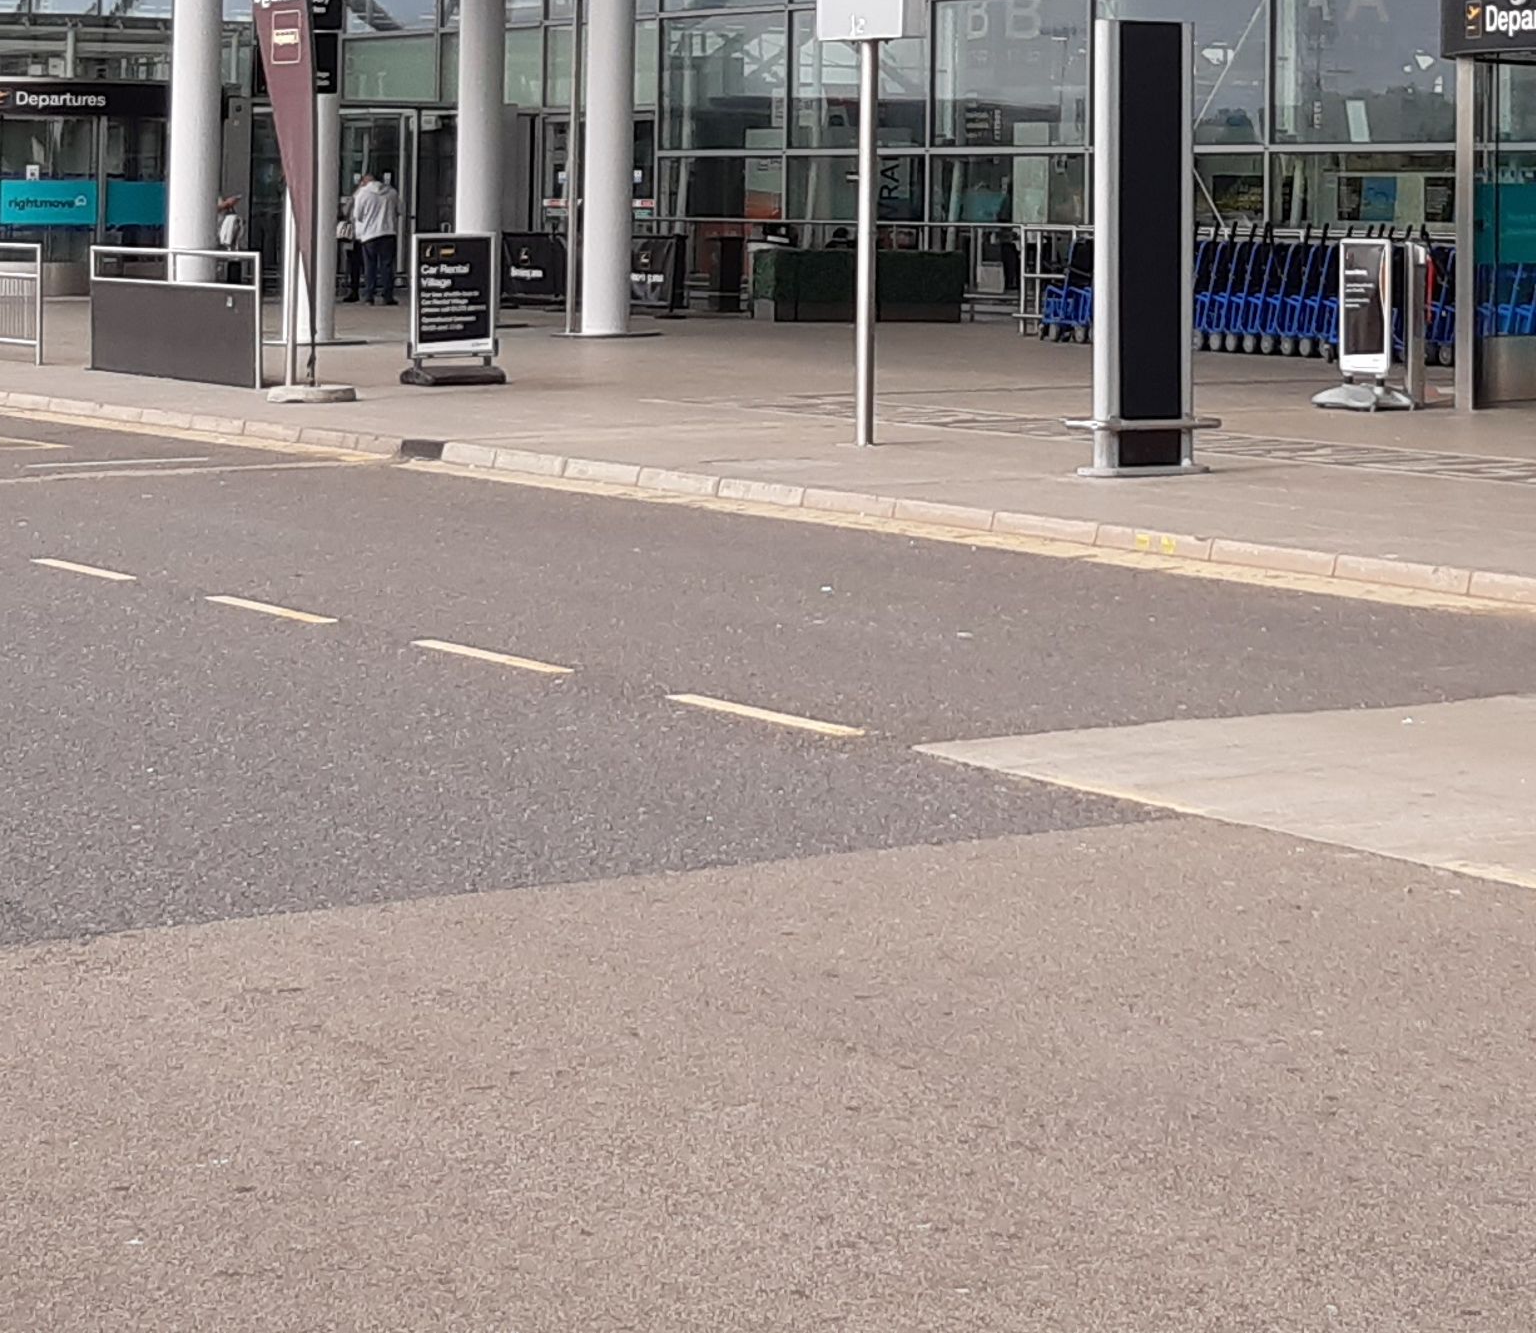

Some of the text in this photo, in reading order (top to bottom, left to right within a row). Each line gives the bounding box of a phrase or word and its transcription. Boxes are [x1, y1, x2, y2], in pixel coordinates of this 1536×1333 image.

[16, 91, 107, 108] Departures
[9, 197, 76, 210] rightmove
[421, 263, 471, 275] Car Rental
[421, 277, 452, 289] Village
